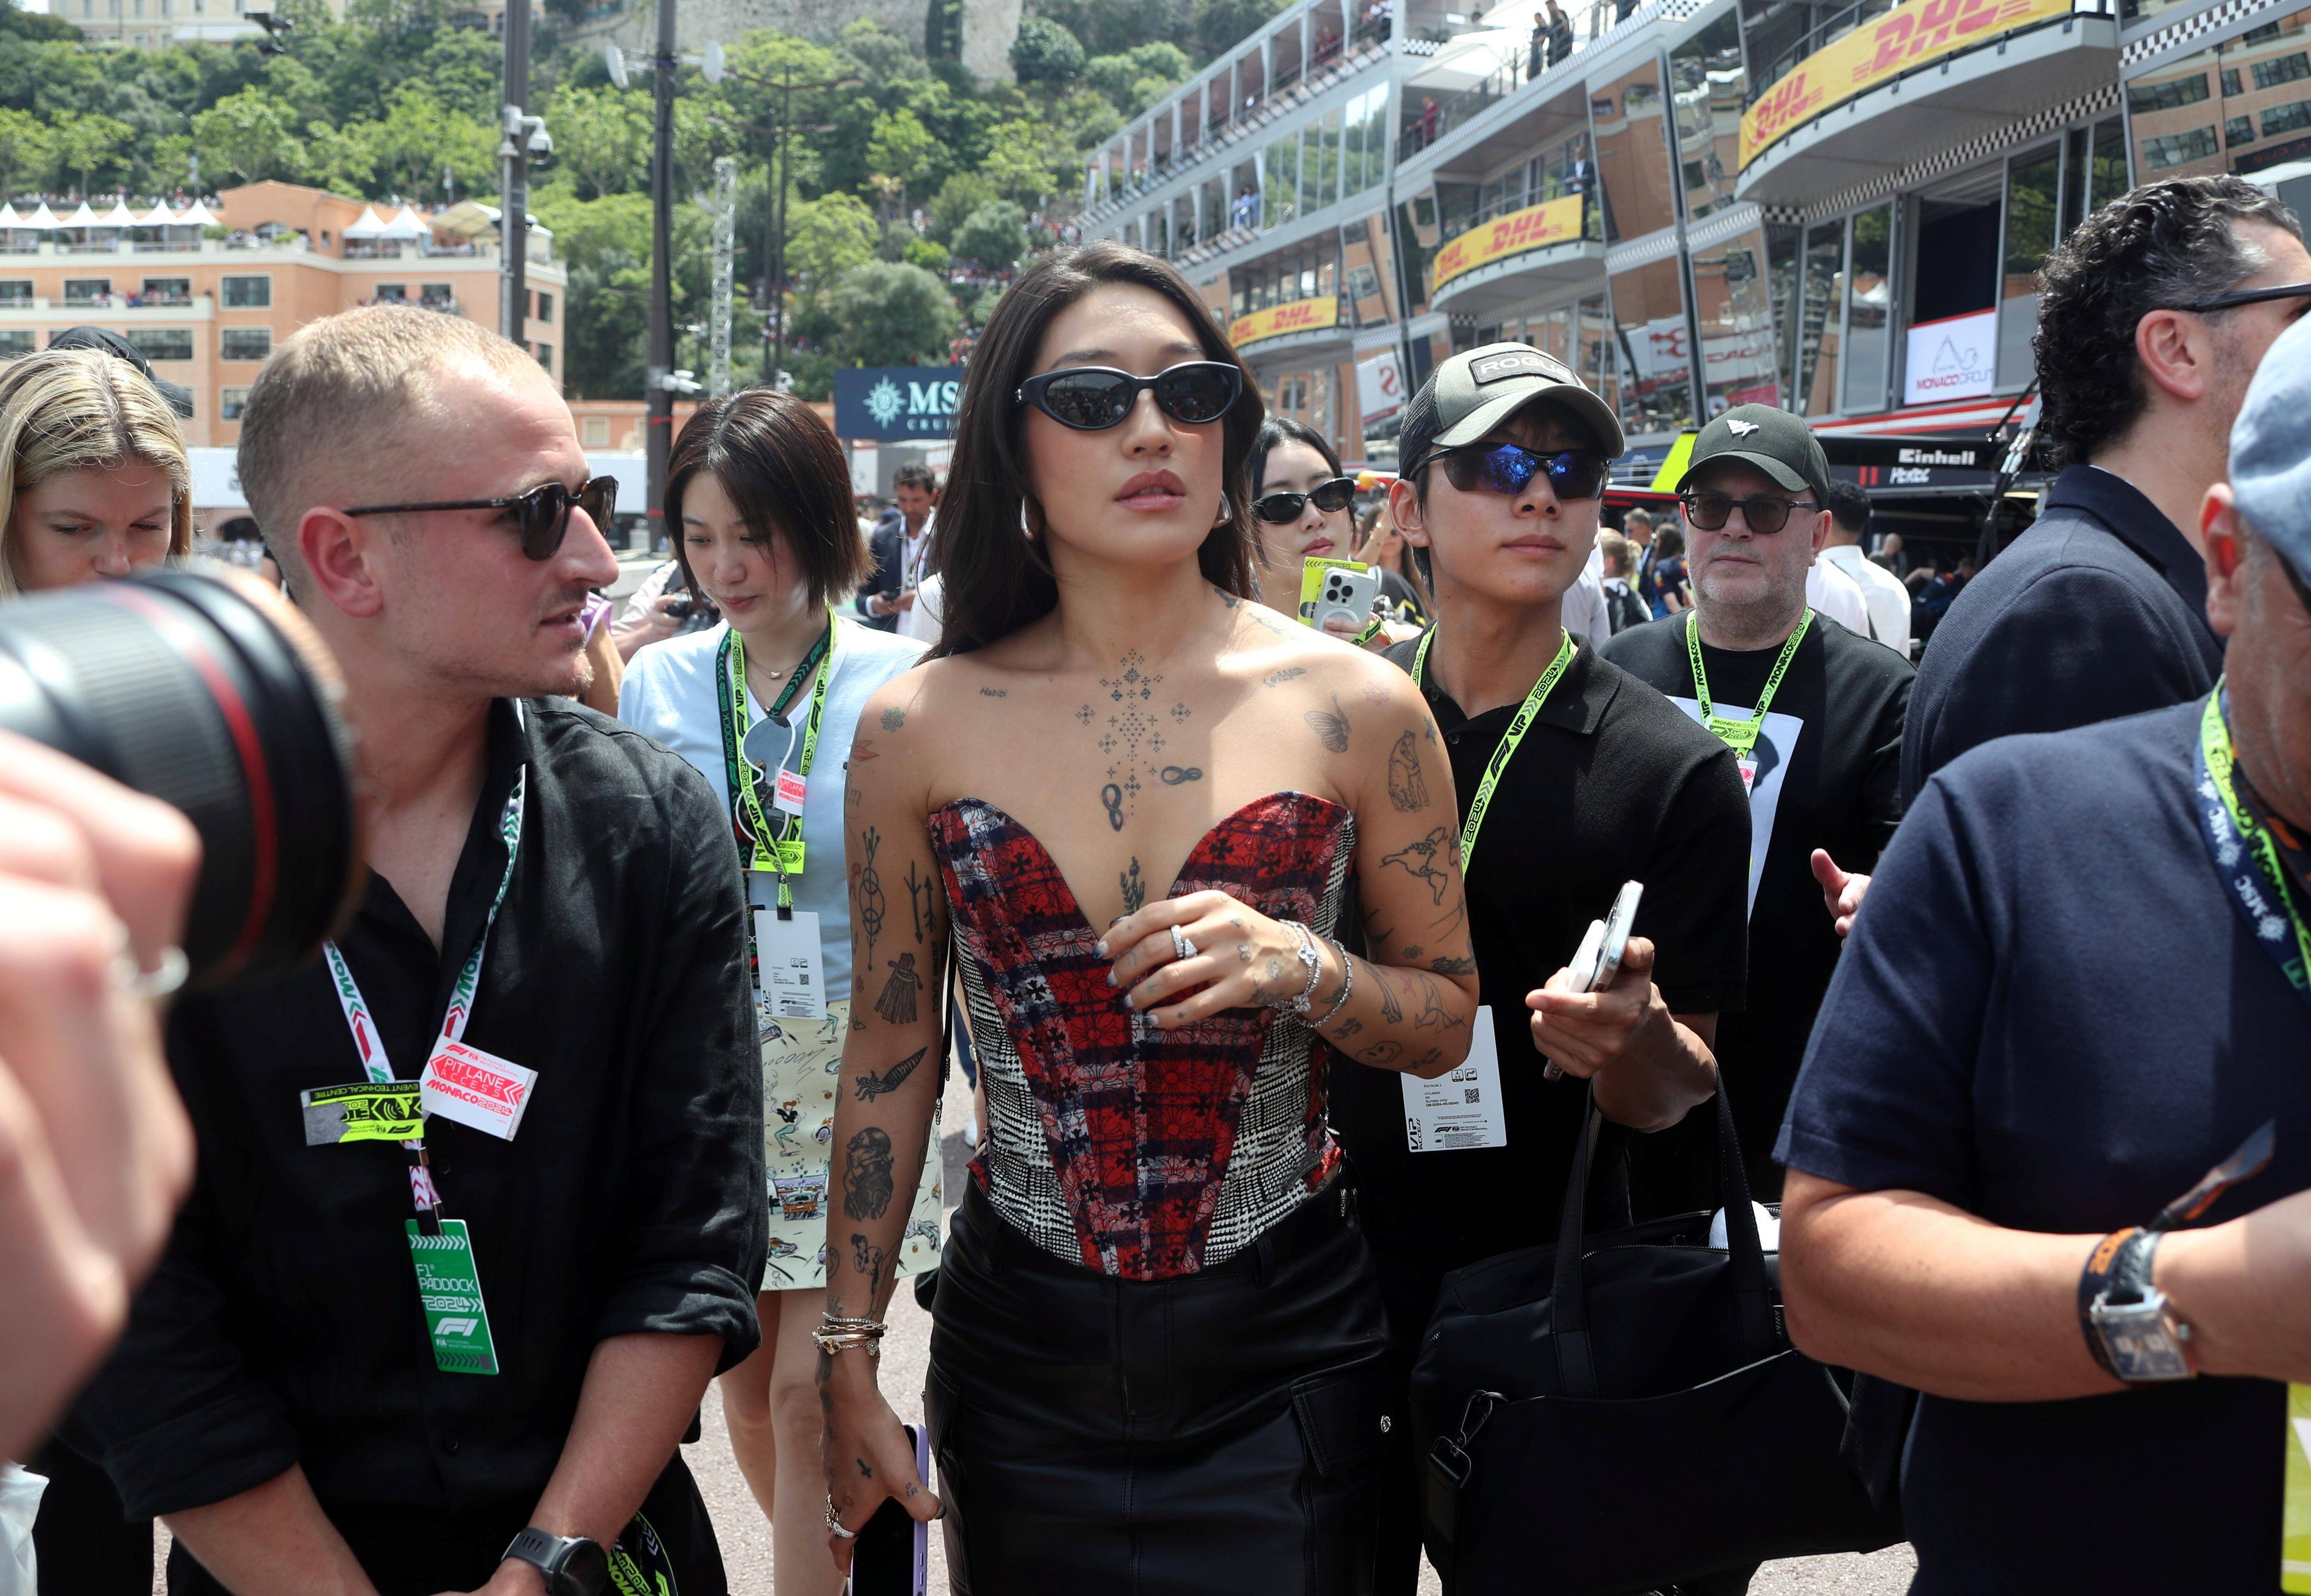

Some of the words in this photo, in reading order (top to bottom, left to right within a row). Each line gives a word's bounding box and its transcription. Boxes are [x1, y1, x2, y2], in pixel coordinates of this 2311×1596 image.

[1871, 0, 2000, 73] DHL
[1755, 70, 1808, 144] DHL
[1492, 210, 1547, 252] DHL
[1274, 305, 1312, 329] DHL
[1480, 357, 1573, 381] ROGUE
[907, 380, 960, 415] MS
[1898, 448, 1975, 465] Einhell
[732, 647, 742, 674] 2024
[815, 680, 825, 698] VIP
[1533, 667, 1559, 699] 2024
[735, 689, 744, 708] VIP
[776, 685, 795, 709] 2024
[1753, 701, 1765, 717] VIP
[722, 715, 735, 758] PADDOCK
[1508, 714, 1526, 736] VIP
[747, 803, 762, 824] VIP
[1464, 798, 1485, 843] 2024
[2234, 875, 2269, 918] MSC
[445, 1044, 469, 1056] F1
[468, 1052, 479, 1061] FIA
[440, 1068, 501, 1097] ACCESS
[444, 1058, 466, 1073] PIT
[466, 1066, 505, 1088] LANE
[315, 1088, 347, 1099] CENTRE
[348, 1085, 391, 1093] TECHNICAL
[343, 1100, 367, 1109] 202
[1408, 1118, 1418, 1150] VIP
[419, 1278, 476, 1291] PADDOCK
[427, 1296, 471, 1310] 2024
[434, 1317, 479, 1336] F1
